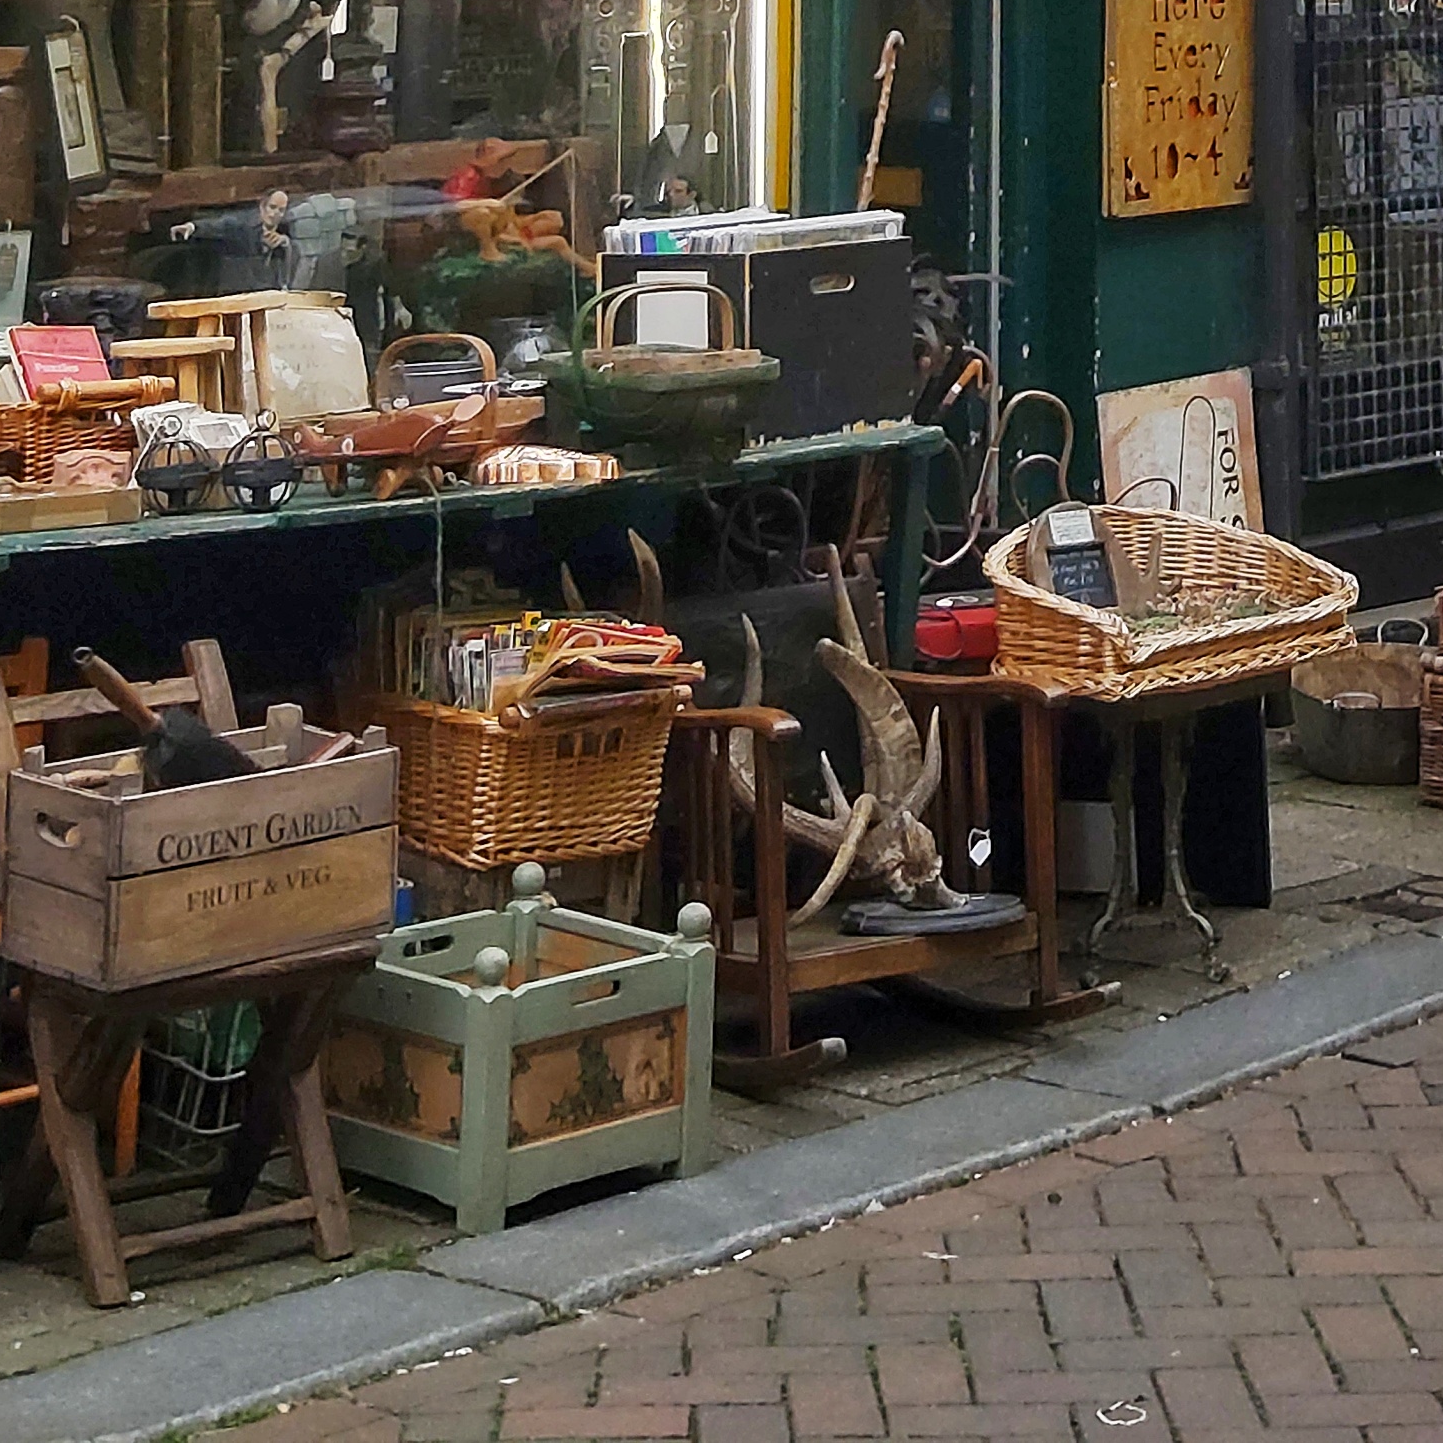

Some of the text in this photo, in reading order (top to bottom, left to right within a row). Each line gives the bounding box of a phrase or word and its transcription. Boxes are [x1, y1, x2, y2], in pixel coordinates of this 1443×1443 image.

[1153, 32, 1231, 81] Every
[1144, 76, 1239, 134] Friday
[1216, 427, 1241, 499] FOR
[157, 804, 363, 864] COVENT GARDEN
[186, 864, 333, 912] FRUIT & VEG
